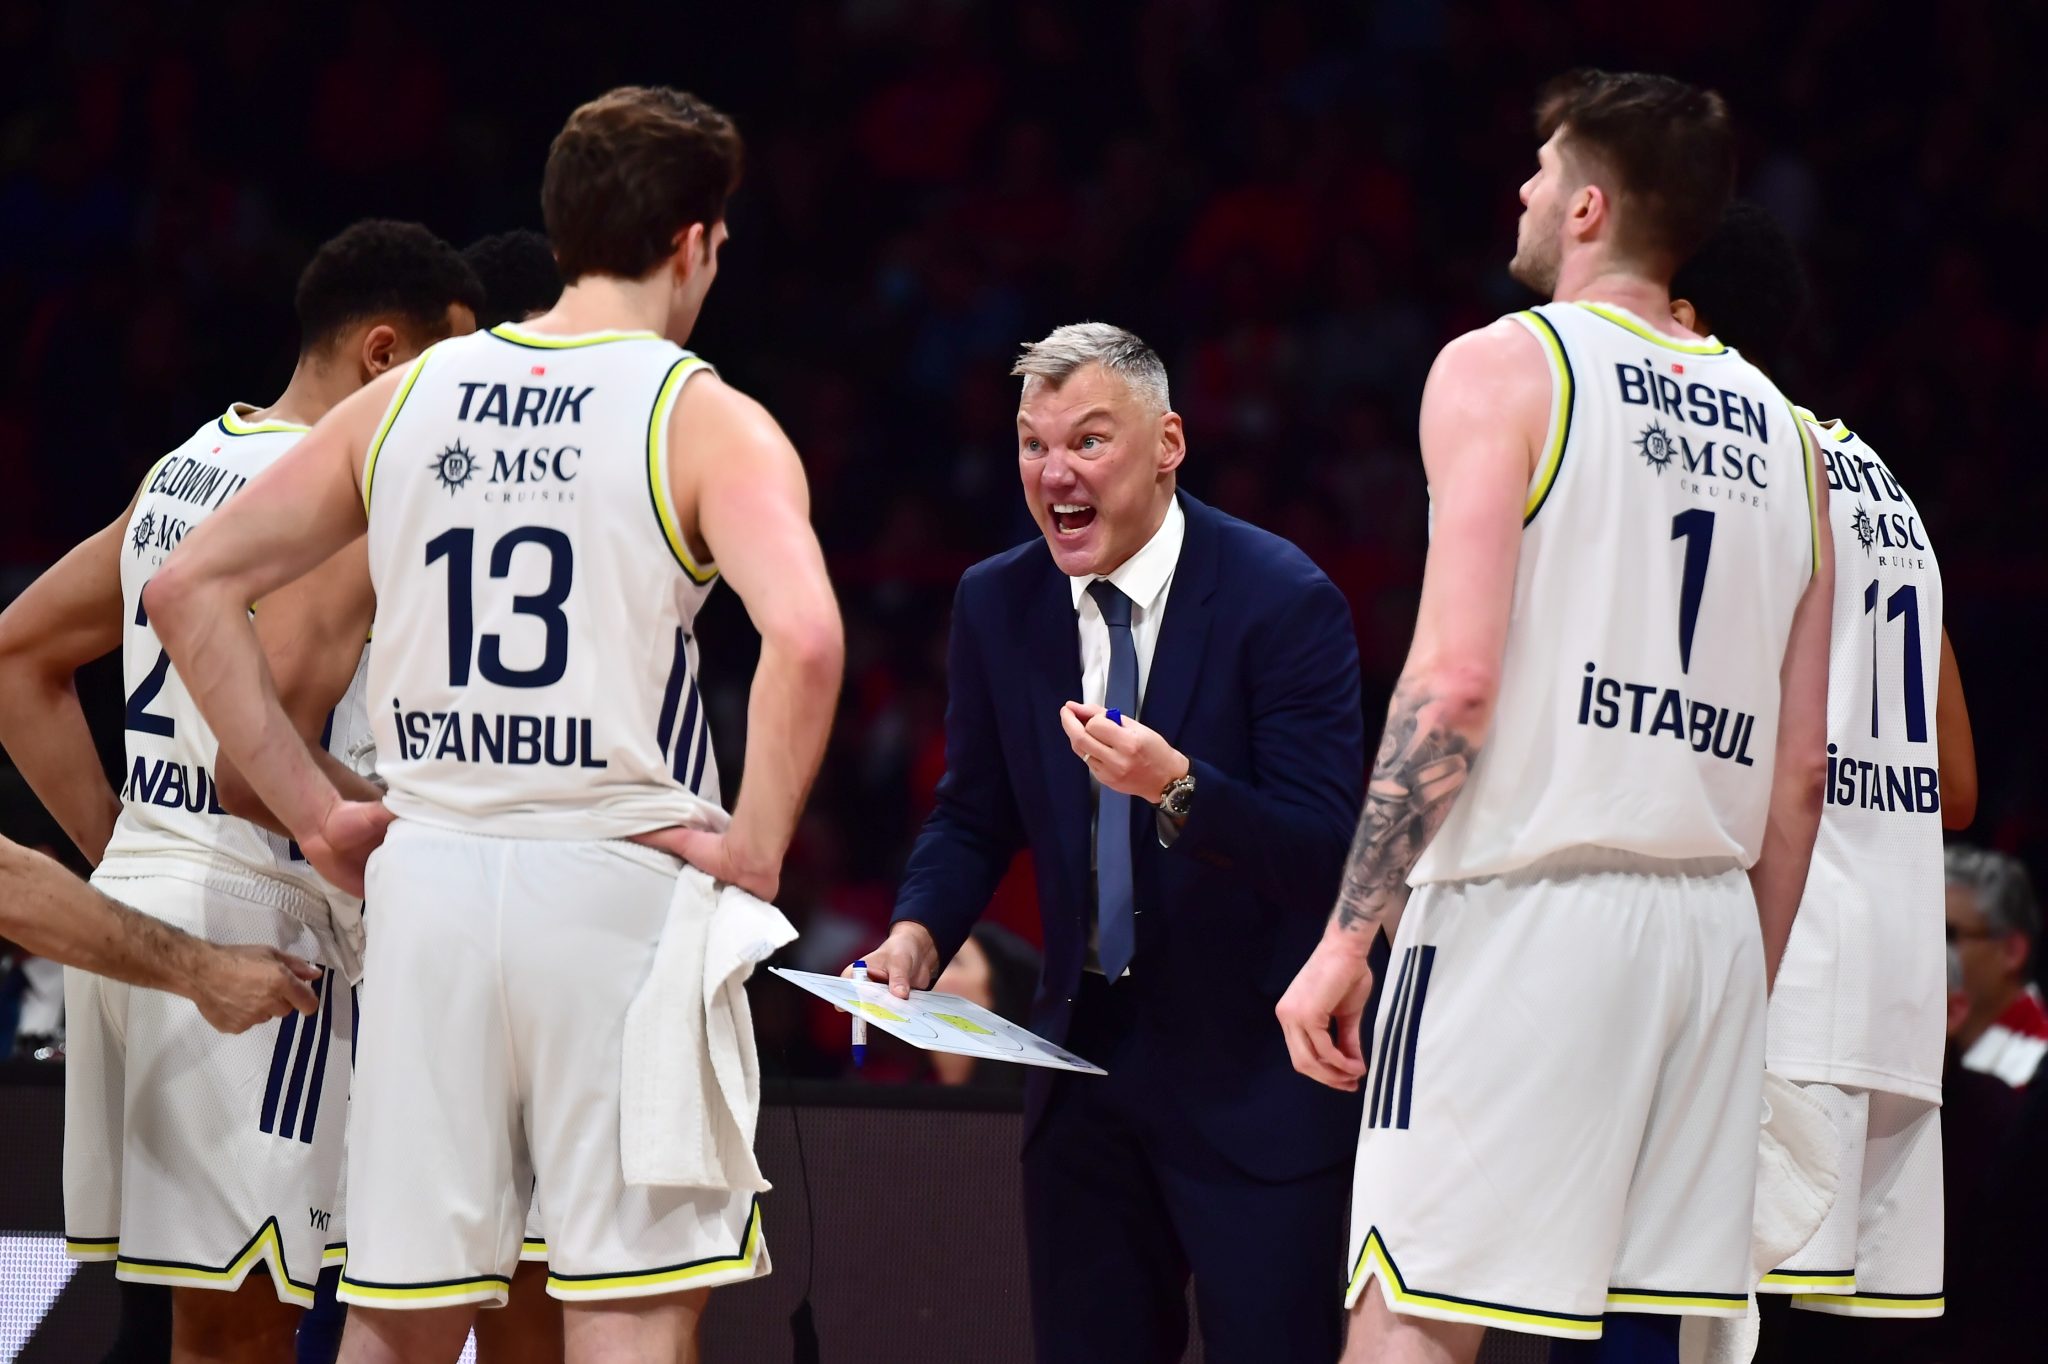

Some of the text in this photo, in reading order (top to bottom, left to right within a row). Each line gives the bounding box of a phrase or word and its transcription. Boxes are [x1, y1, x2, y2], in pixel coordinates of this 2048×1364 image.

[458, 382, 595, 427] TARIK
[1615, 358, 1768, 444] BİRSEN
[487, 445, 582, 484] MSC
[1678, 434, 1769, 489] MSC
[155, 514, 196, 551] MS
[1878, 556, 1924, 570] RUISE
[425, 526, 573, 688] 13
[1671, 508, 1715, 675] 1
[1865, 579, 1928, 743] 11
[1578, 662, 1755, 767] İSTABUL
